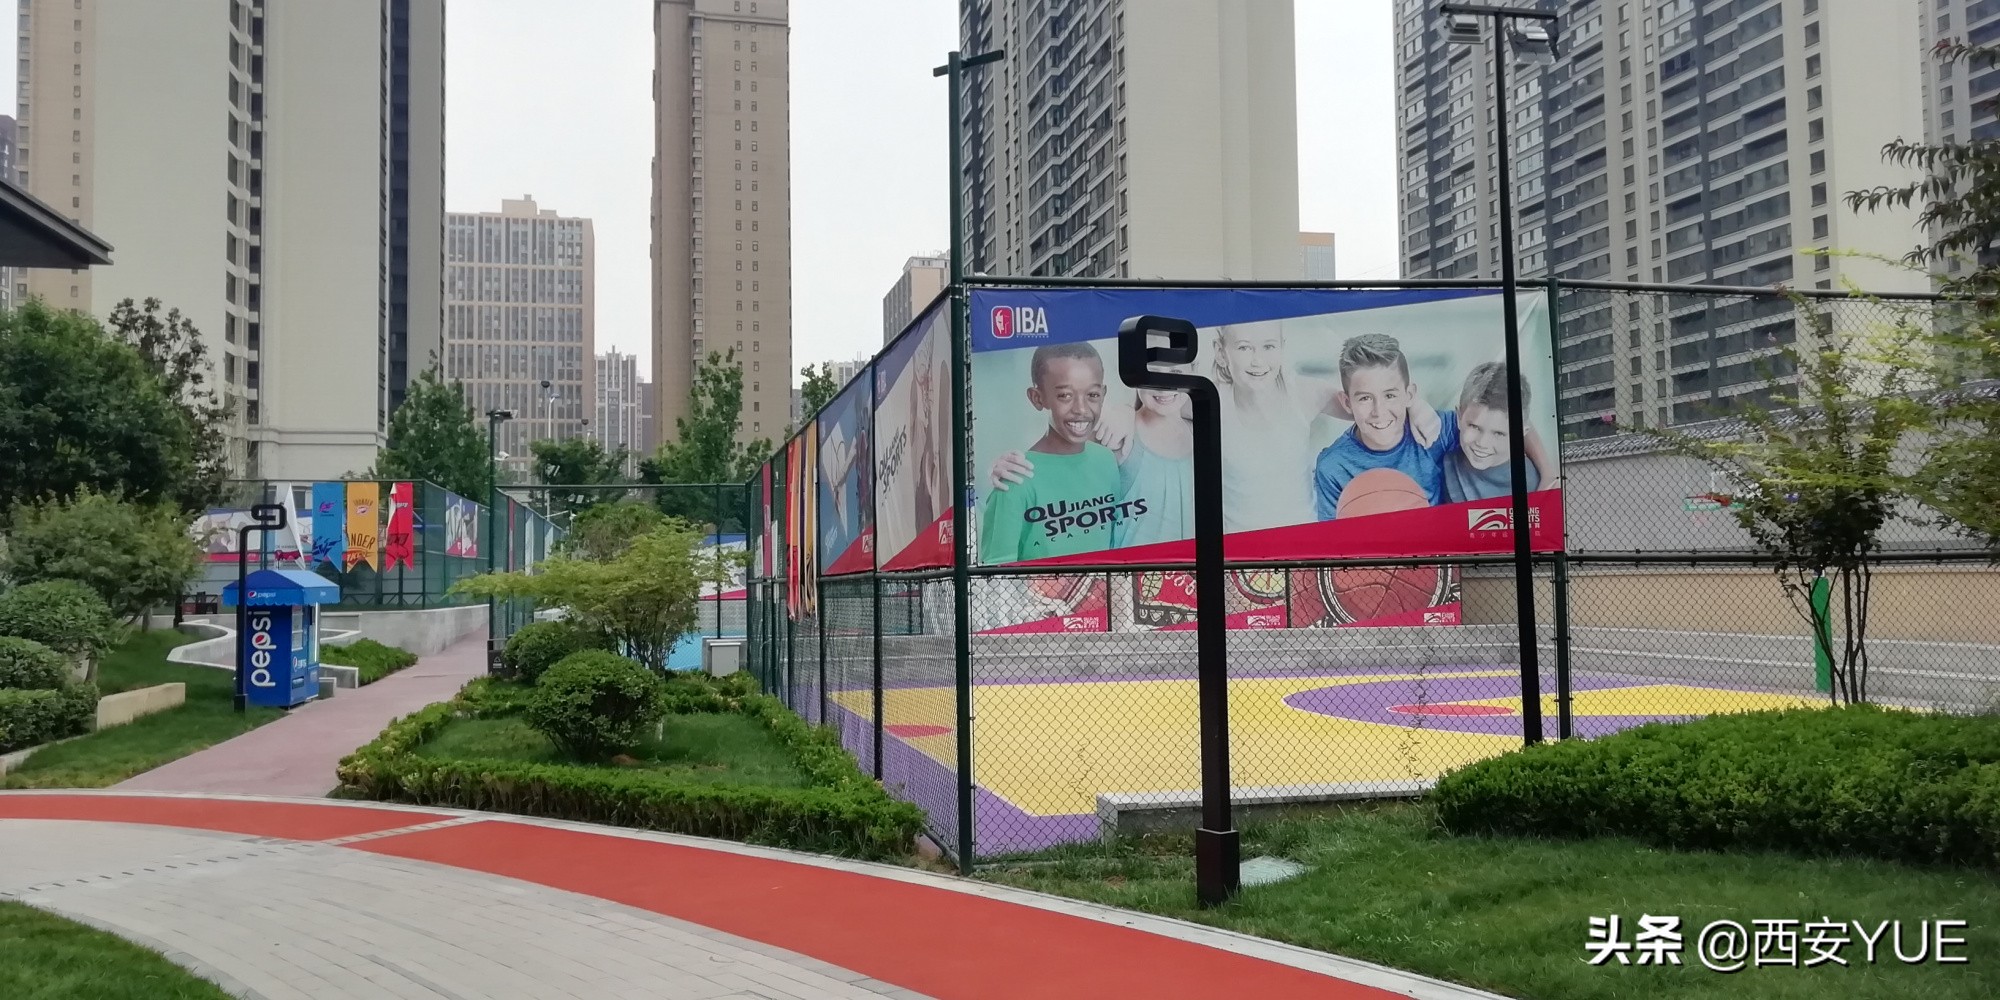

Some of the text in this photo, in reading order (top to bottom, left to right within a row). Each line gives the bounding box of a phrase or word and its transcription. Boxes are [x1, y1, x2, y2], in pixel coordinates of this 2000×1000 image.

[1015, 306, 1049, 333] IBA
[1023, 493, 1116, 523] QUJIANG
[1043, 498, 1148, 538] SPORTS
[1033, 517, 1139, 546] ACADEMY
[248, 610, 277, 688] pepsi
